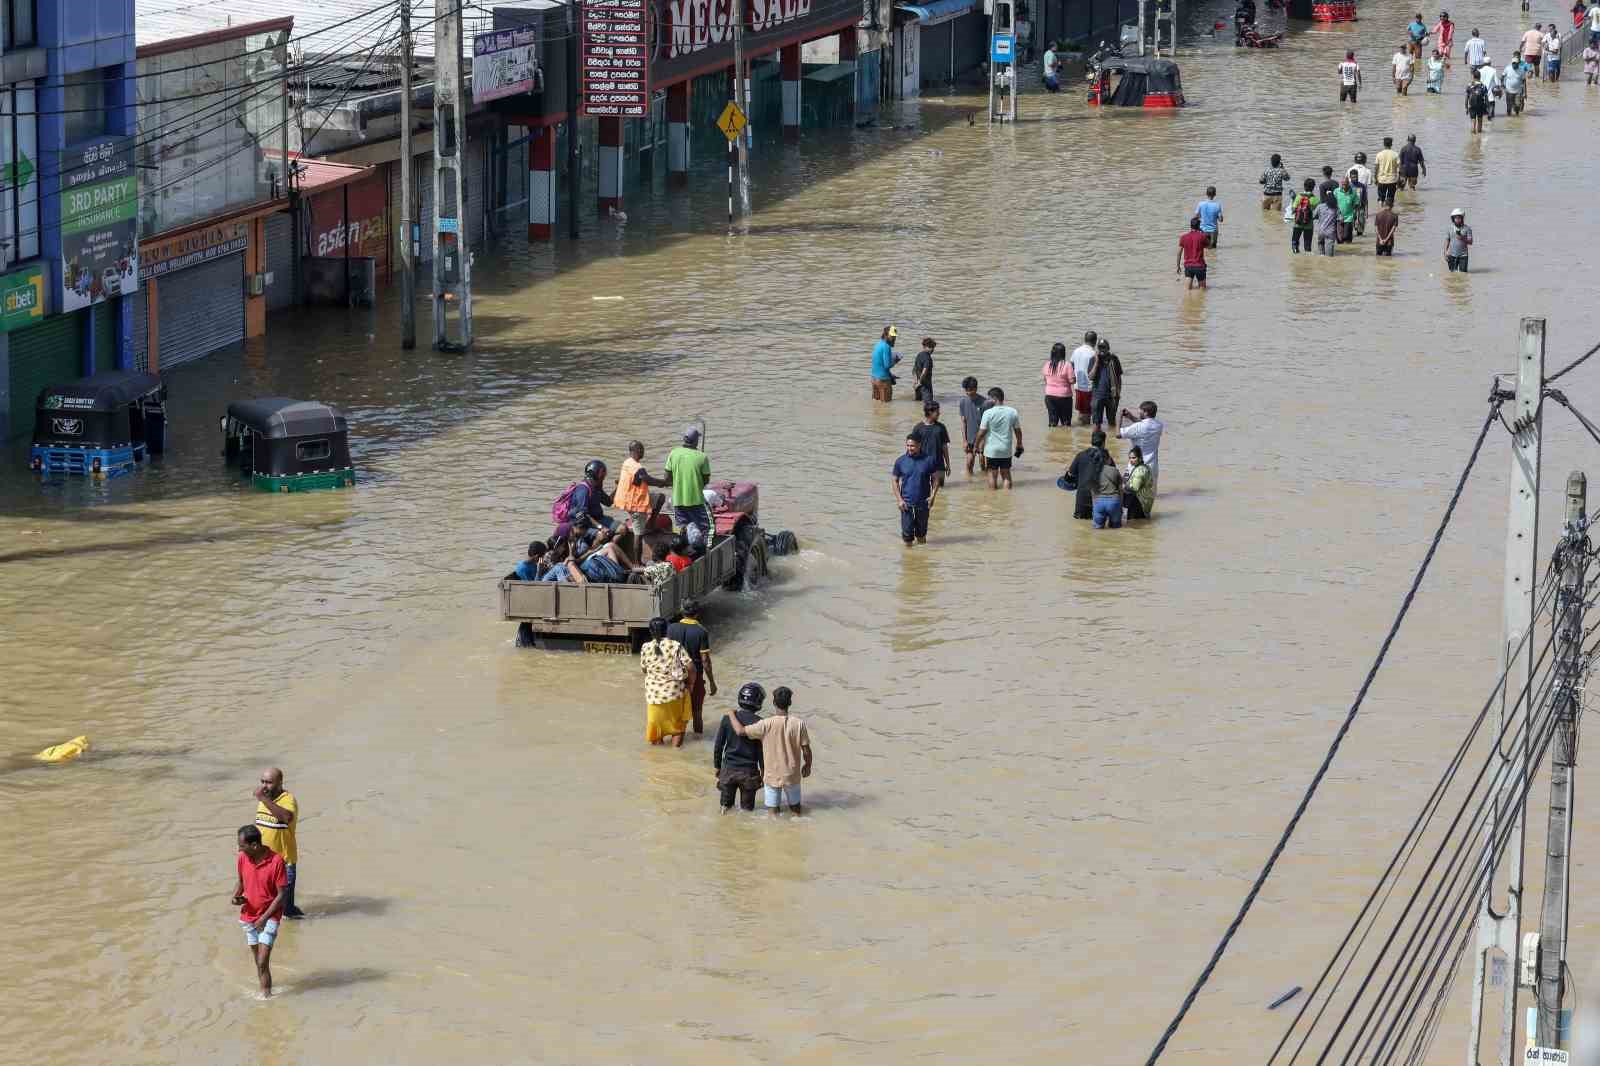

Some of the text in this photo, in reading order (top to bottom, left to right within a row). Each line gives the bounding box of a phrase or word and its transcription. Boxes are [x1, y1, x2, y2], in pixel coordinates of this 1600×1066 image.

[70, 182, 128, 214] 3RD PARTY
[79, 206, 121, 226] INSURANCE
